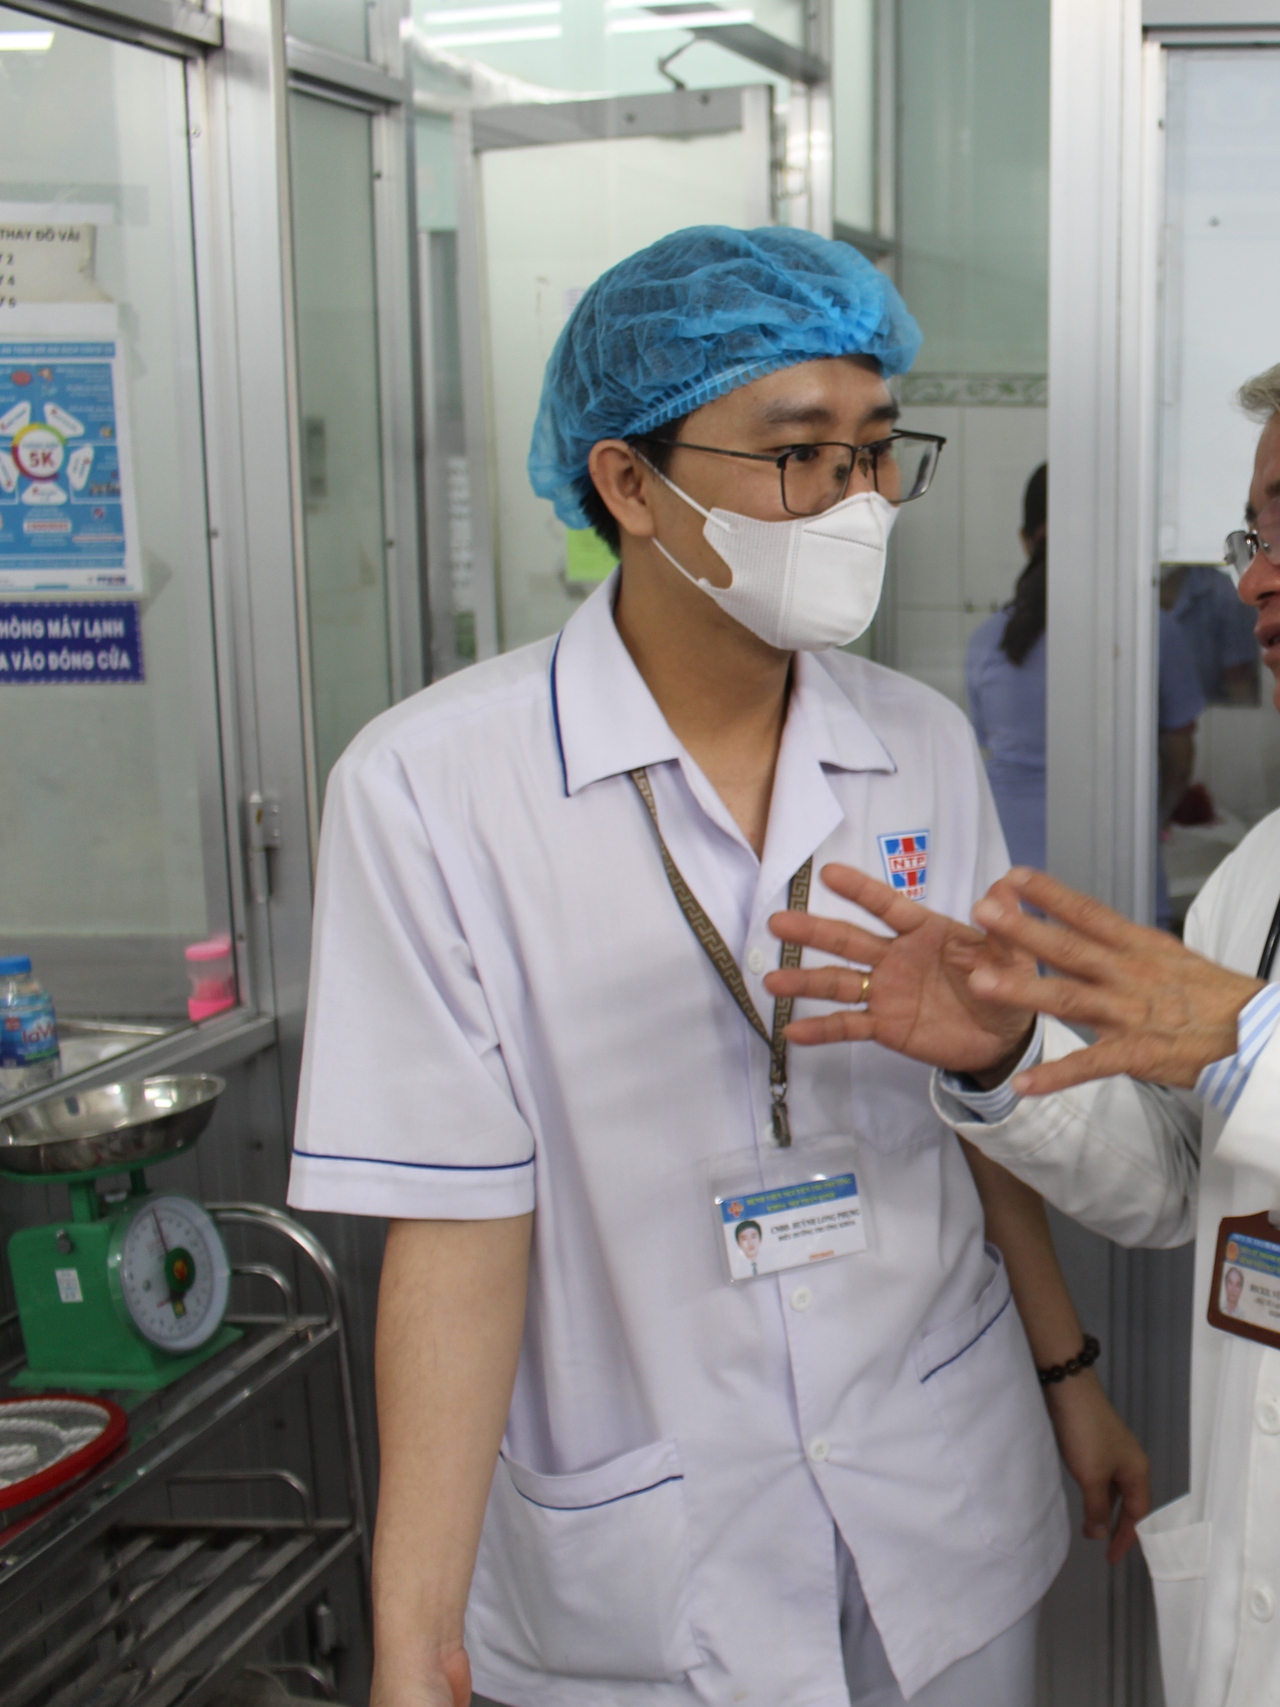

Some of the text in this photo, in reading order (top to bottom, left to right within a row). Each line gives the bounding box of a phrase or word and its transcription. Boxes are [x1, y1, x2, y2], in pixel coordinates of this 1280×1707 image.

[29, 450, 55, 468] 5K
[47, 613, 81, 639] MÁY
[83, 618, 124, 643] LẠNH
[10, 645, 46, 671] VÀO
[893, 857, 925, 870] NTP
